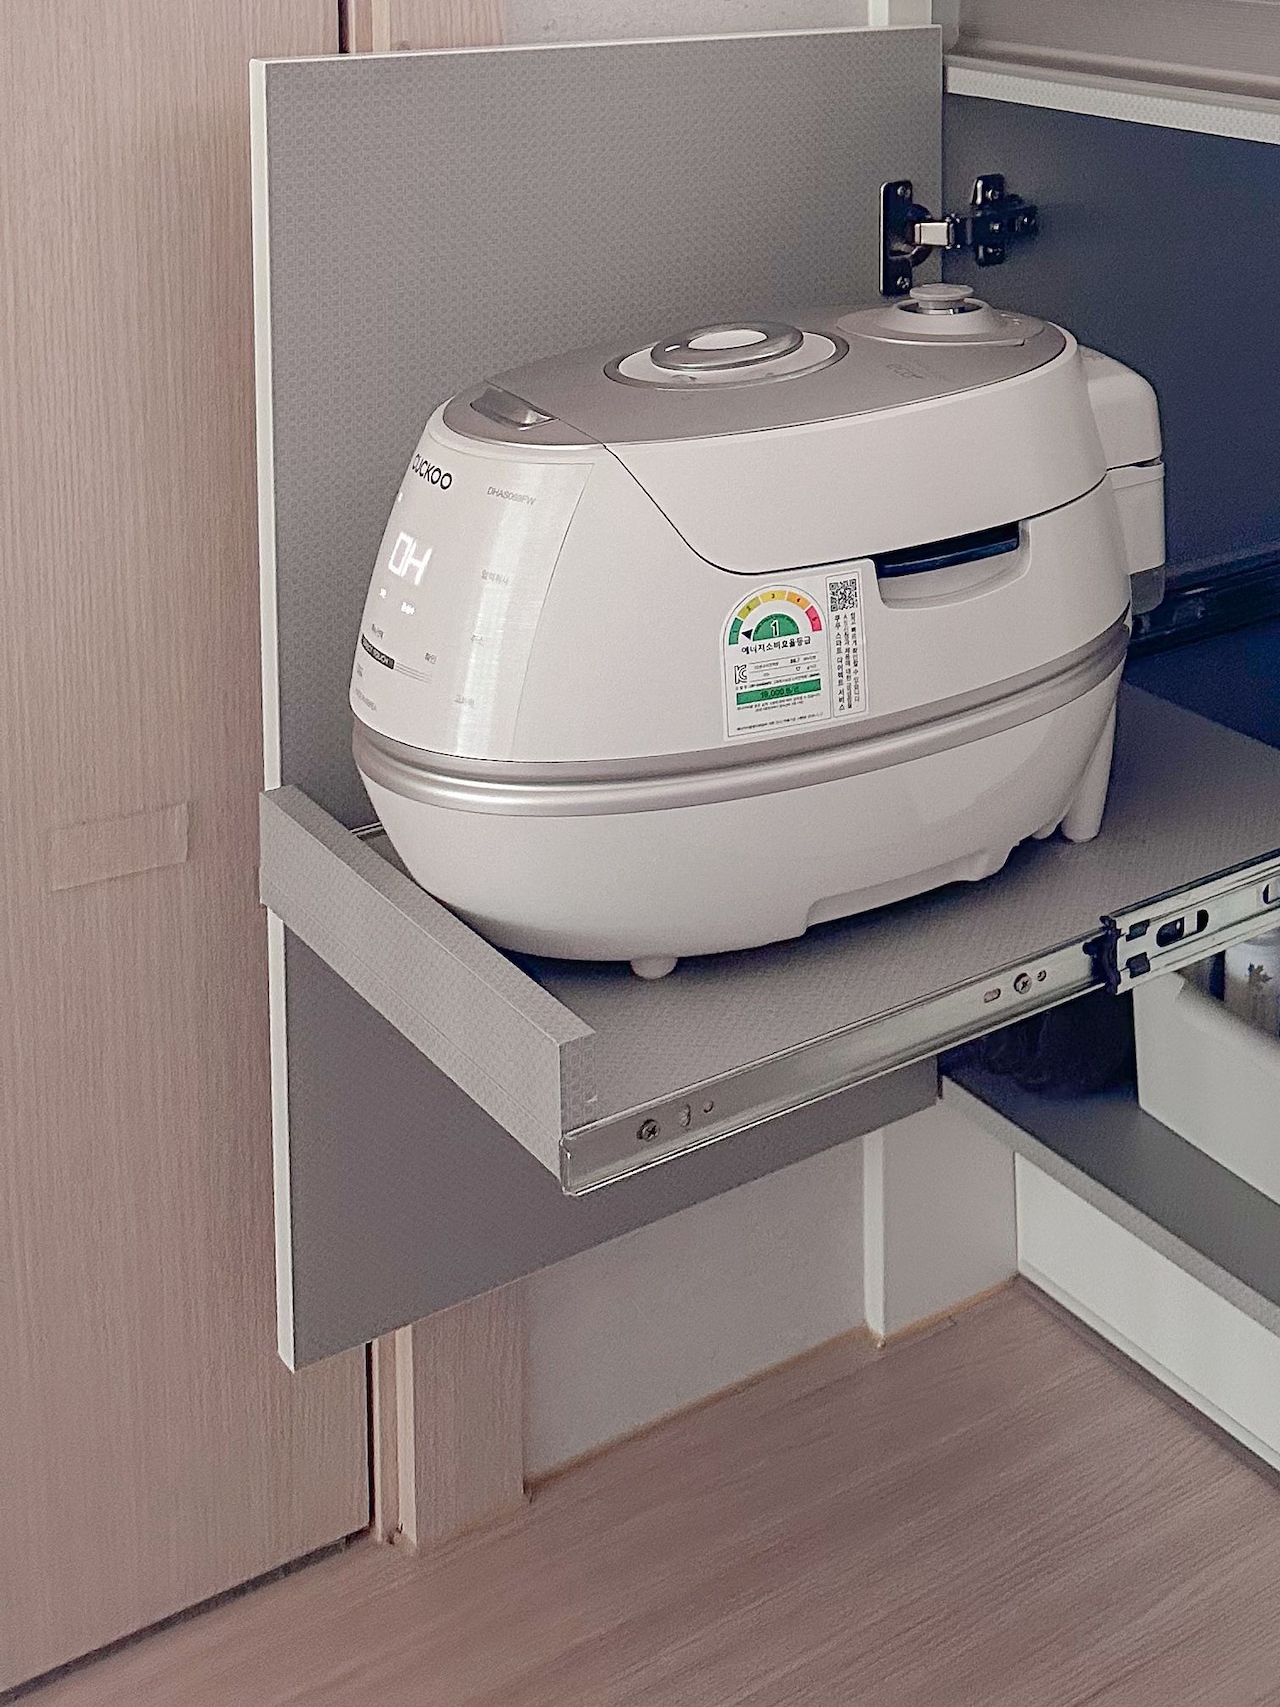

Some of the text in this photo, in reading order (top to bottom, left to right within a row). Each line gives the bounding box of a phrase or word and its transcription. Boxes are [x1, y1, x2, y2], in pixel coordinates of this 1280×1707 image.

[411, 453, 453, 490] CUCKOO
[771, 620, 780, 637] 1
[741, 635, 811, 655] 에너지소비효율등급
